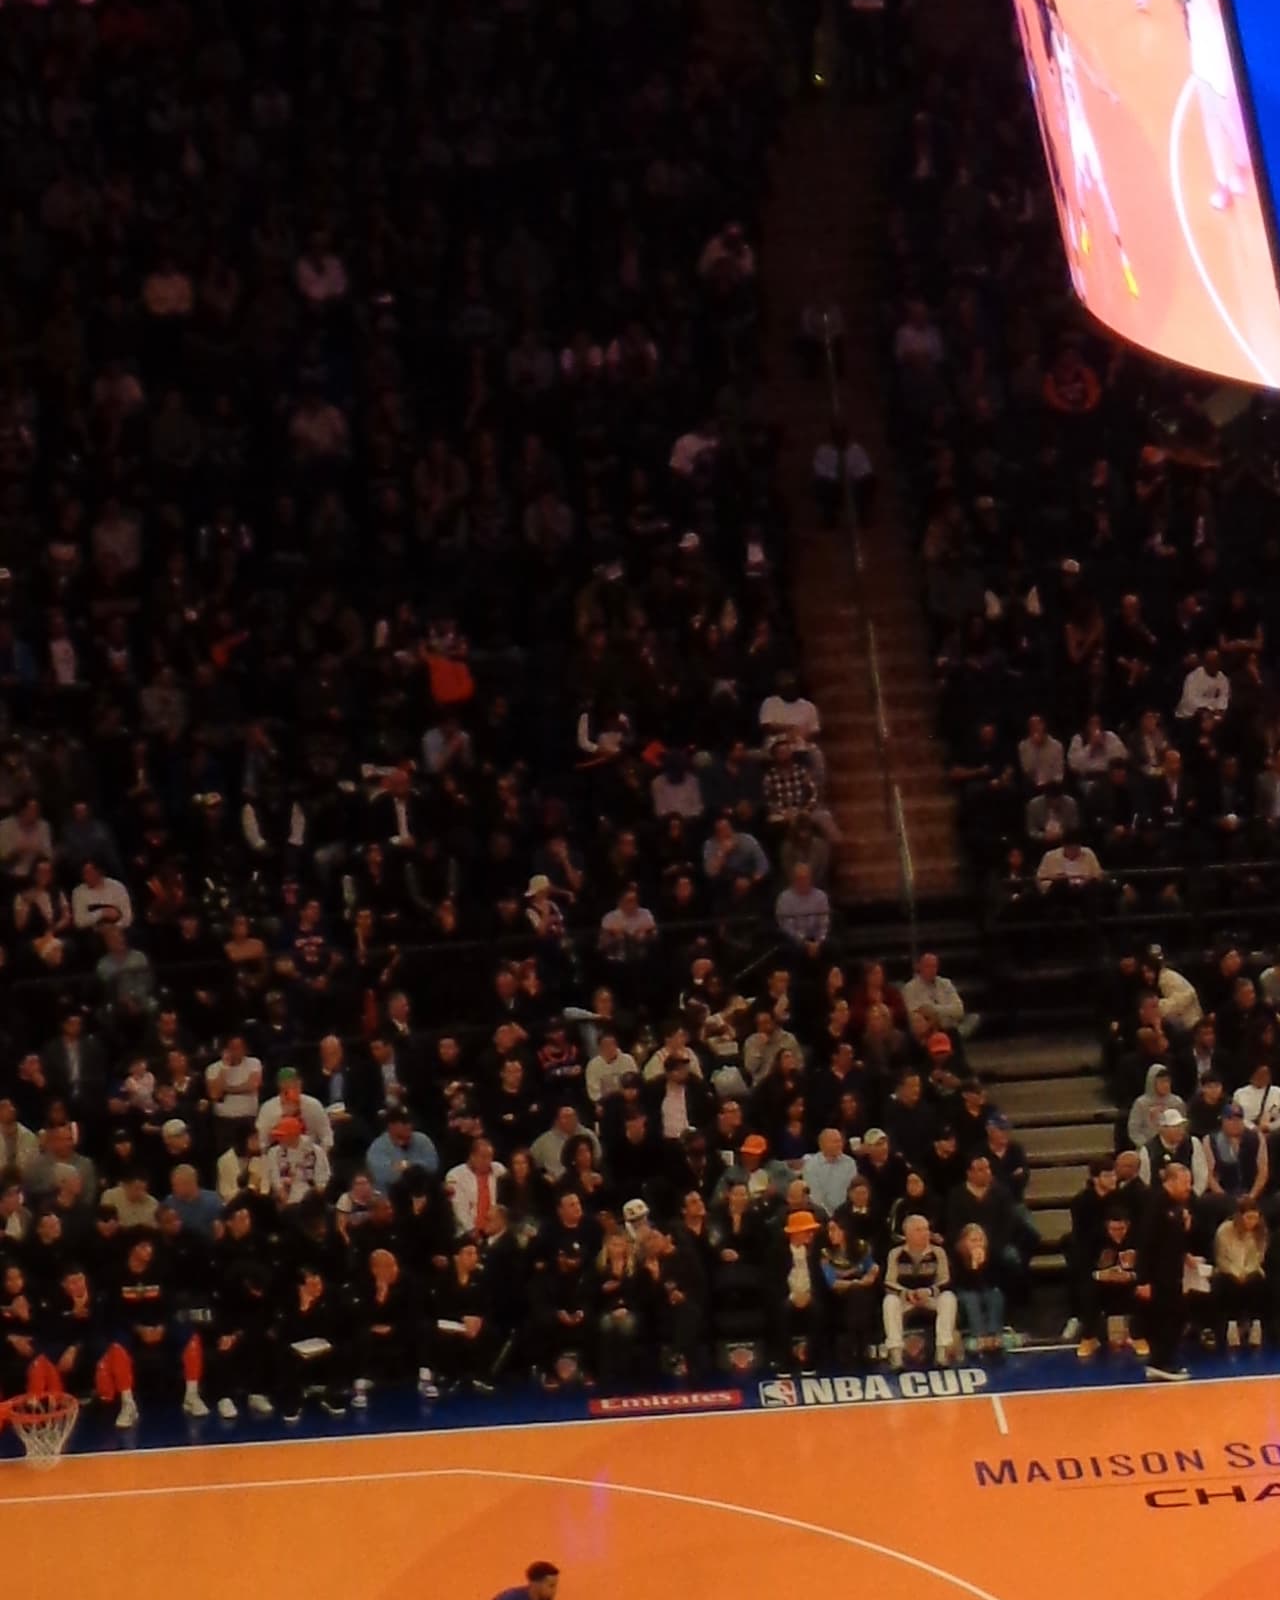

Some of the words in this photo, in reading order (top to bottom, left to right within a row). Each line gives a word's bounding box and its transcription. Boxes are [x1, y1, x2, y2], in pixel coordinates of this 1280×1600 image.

[601, 1391, 733, 1411] Emirates
[802, 1376, 894, 1406] NBA
[901, 1368, 988, 1398] CUP
[973, 1449, 1205, 1487] MADISON
